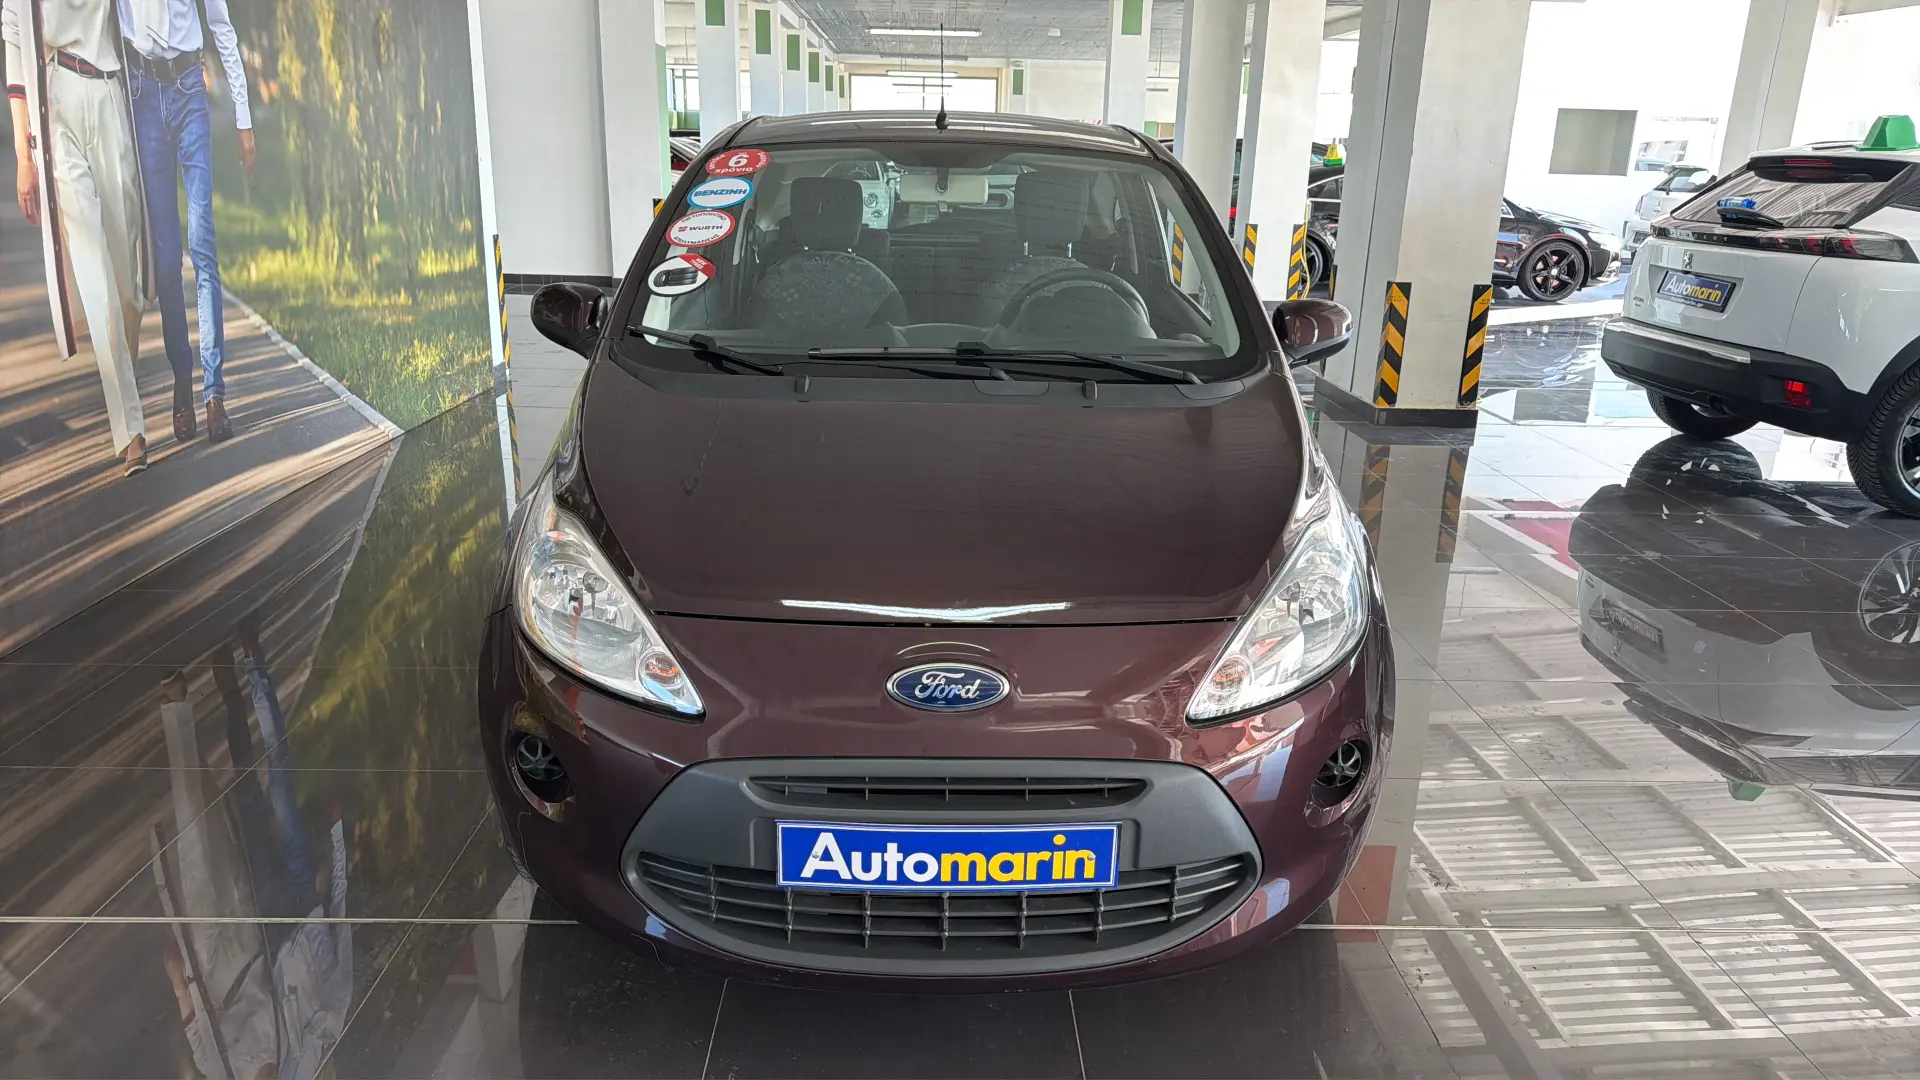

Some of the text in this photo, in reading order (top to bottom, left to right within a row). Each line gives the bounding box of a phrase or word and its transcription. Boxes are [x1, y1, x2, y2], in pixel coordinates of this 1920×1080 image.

[728, 154, 749, 167] 6
[1664, 275, 1722, 302] Automarin
[914, 671, 982, 700] Ford
[800, 832, 1096, 882] Automarin
